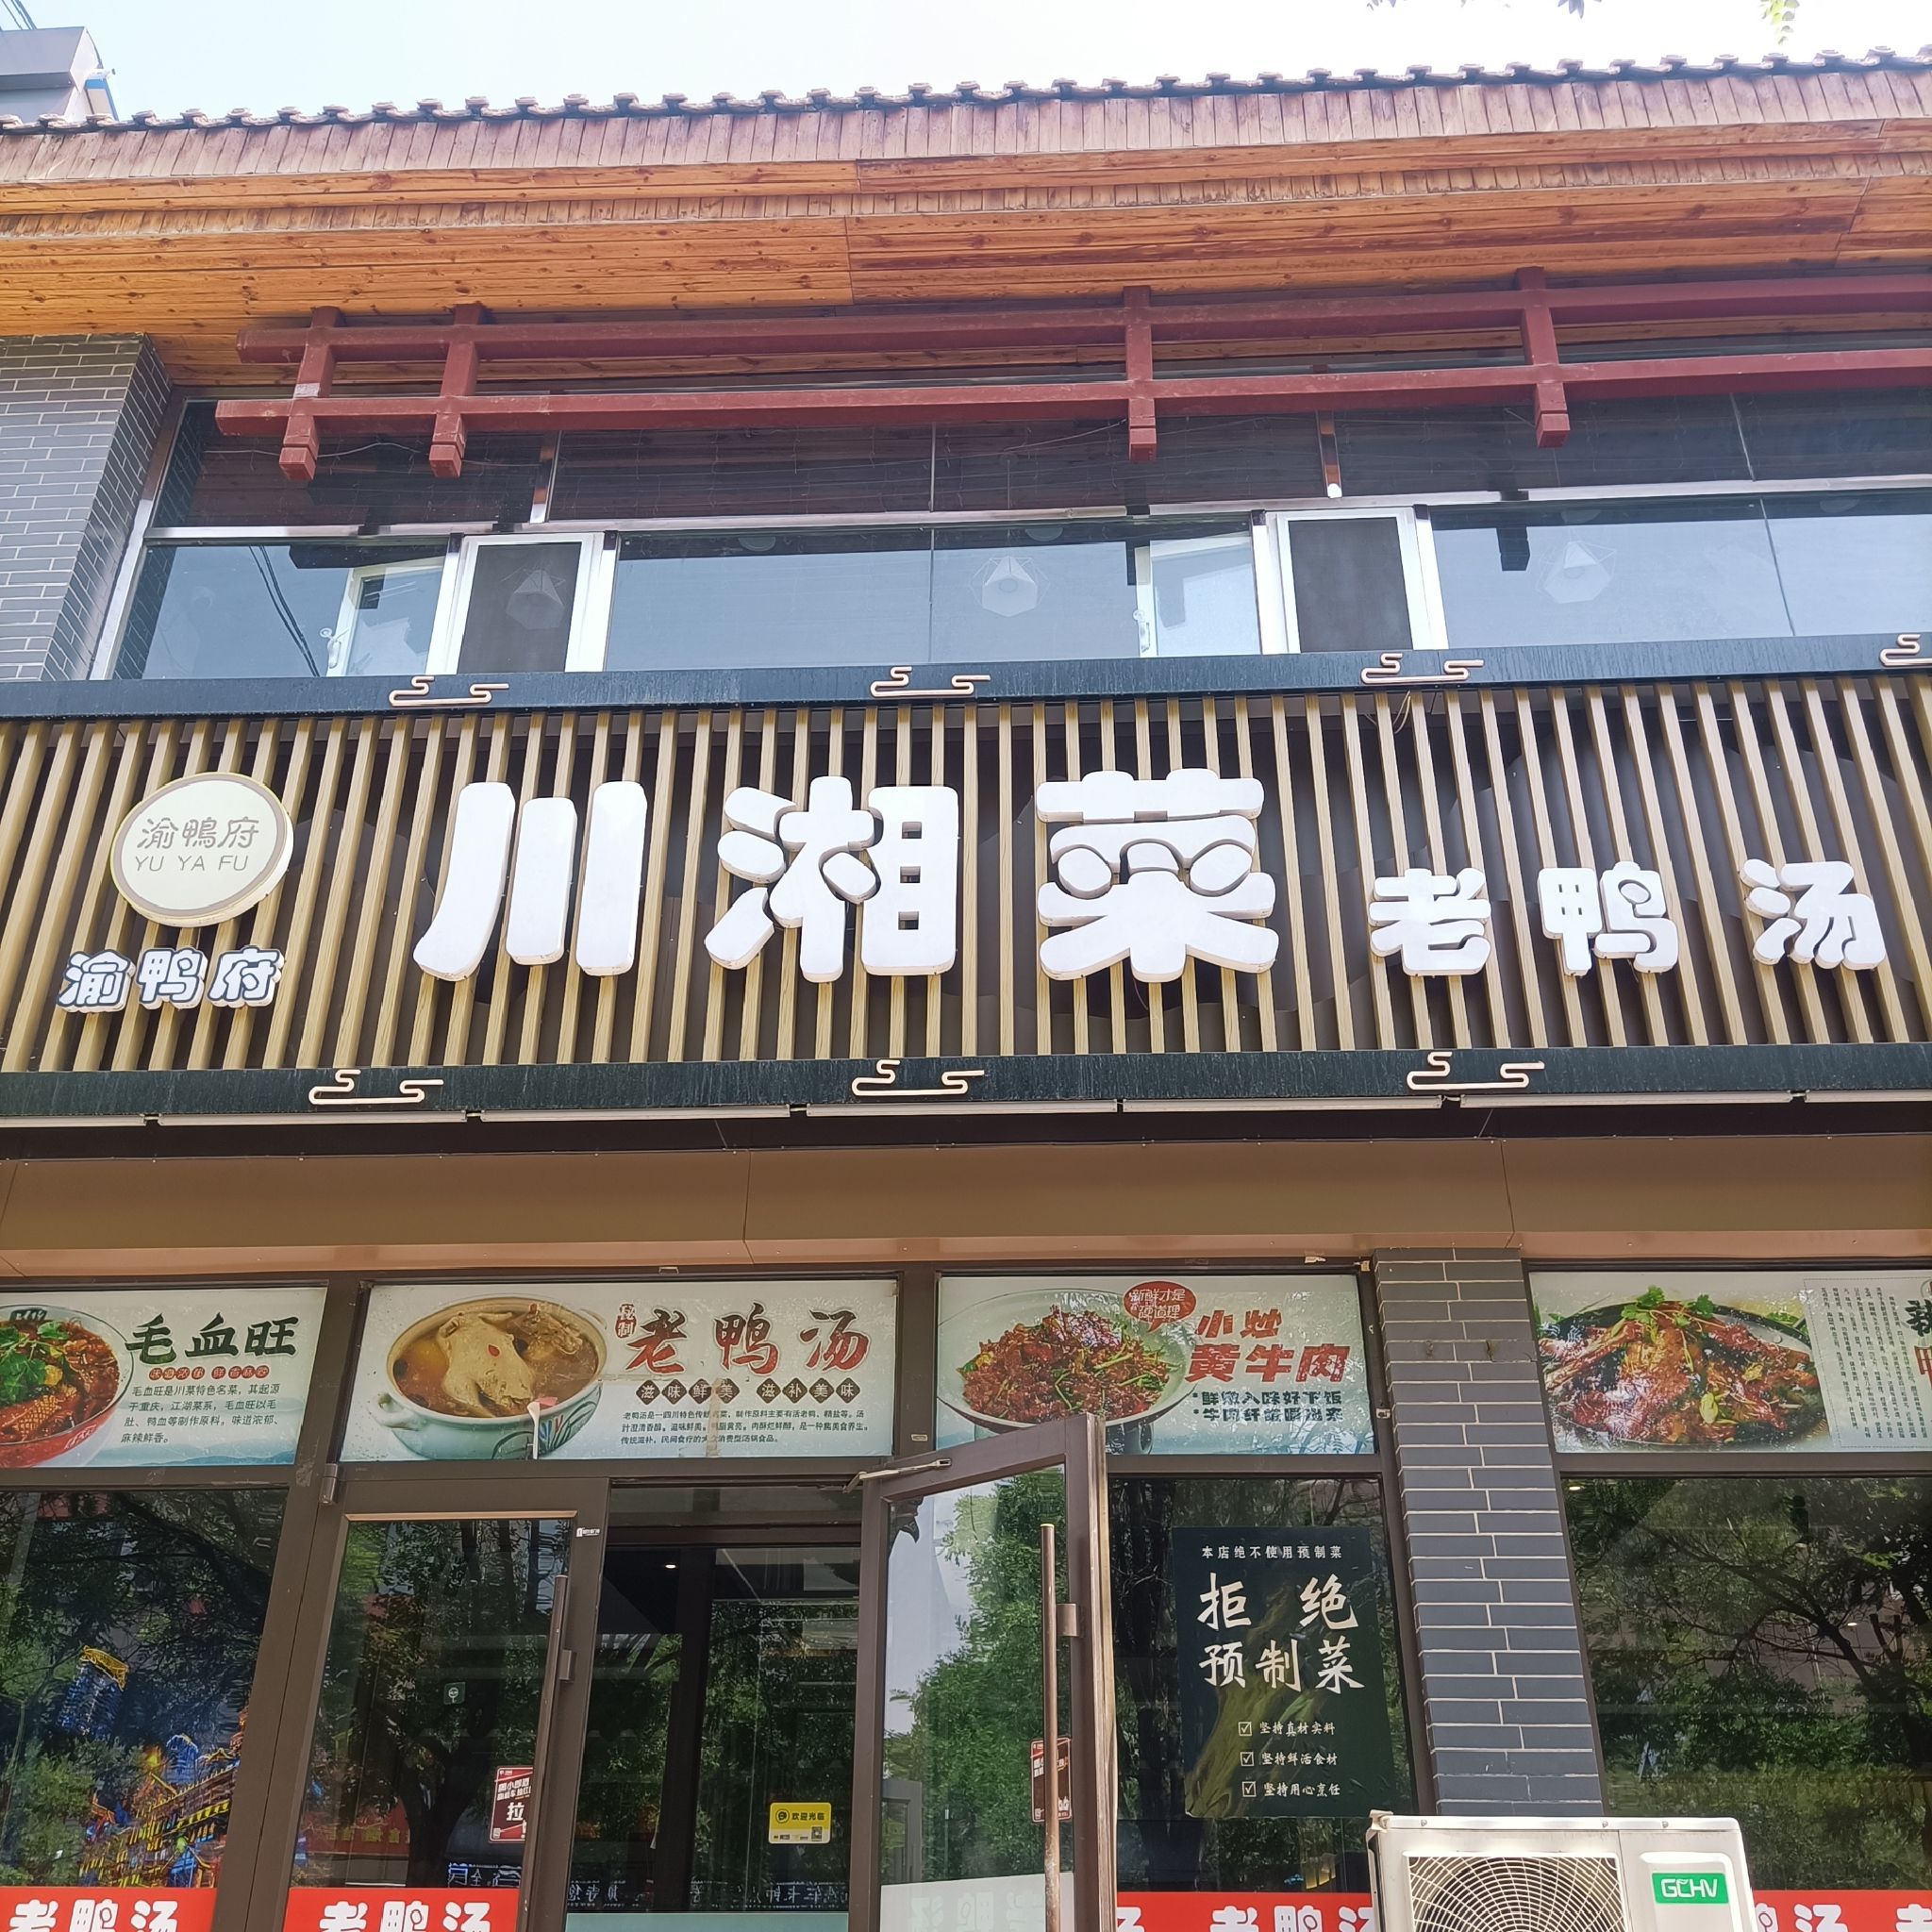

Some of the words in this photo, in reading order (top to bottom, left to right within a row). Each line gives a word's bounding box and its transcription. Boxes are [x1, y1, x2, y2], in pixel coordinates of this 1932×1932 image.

[135, 855, 164, 872] YU
[177, 855, 206, 872] YA
[218, 855, 248, 872] FU
[413, 768, 1280, 982] 川湘菜
[1369, 858, 1887, 976] 老鸭汤
[57, 945, 284, 1013] 渝鸭府
[125, 1312, 299, 1364] 毛血旺
[626, 1302, 869, 1374] 老鸭汤
[1194, 1308, 1282, 1339] 小炒
[1185, 1343, 1350, 1383] 黄牛肉
[757, 1377, 860, 1403] 滋补美味
[1202, 1545, 1342, 1558] 本店绝不使用预制菜
[1197, 1572, 1358, 1631] 拒绝
[1199, 1635, 1365, 1694] 预制菜
[1259, 1721, 1335, 1737] 坚持真材实料
[1261, 1751, 1338, 1766] 坚持鲜活食材
[506, 1802, 525, 1821] 拉
